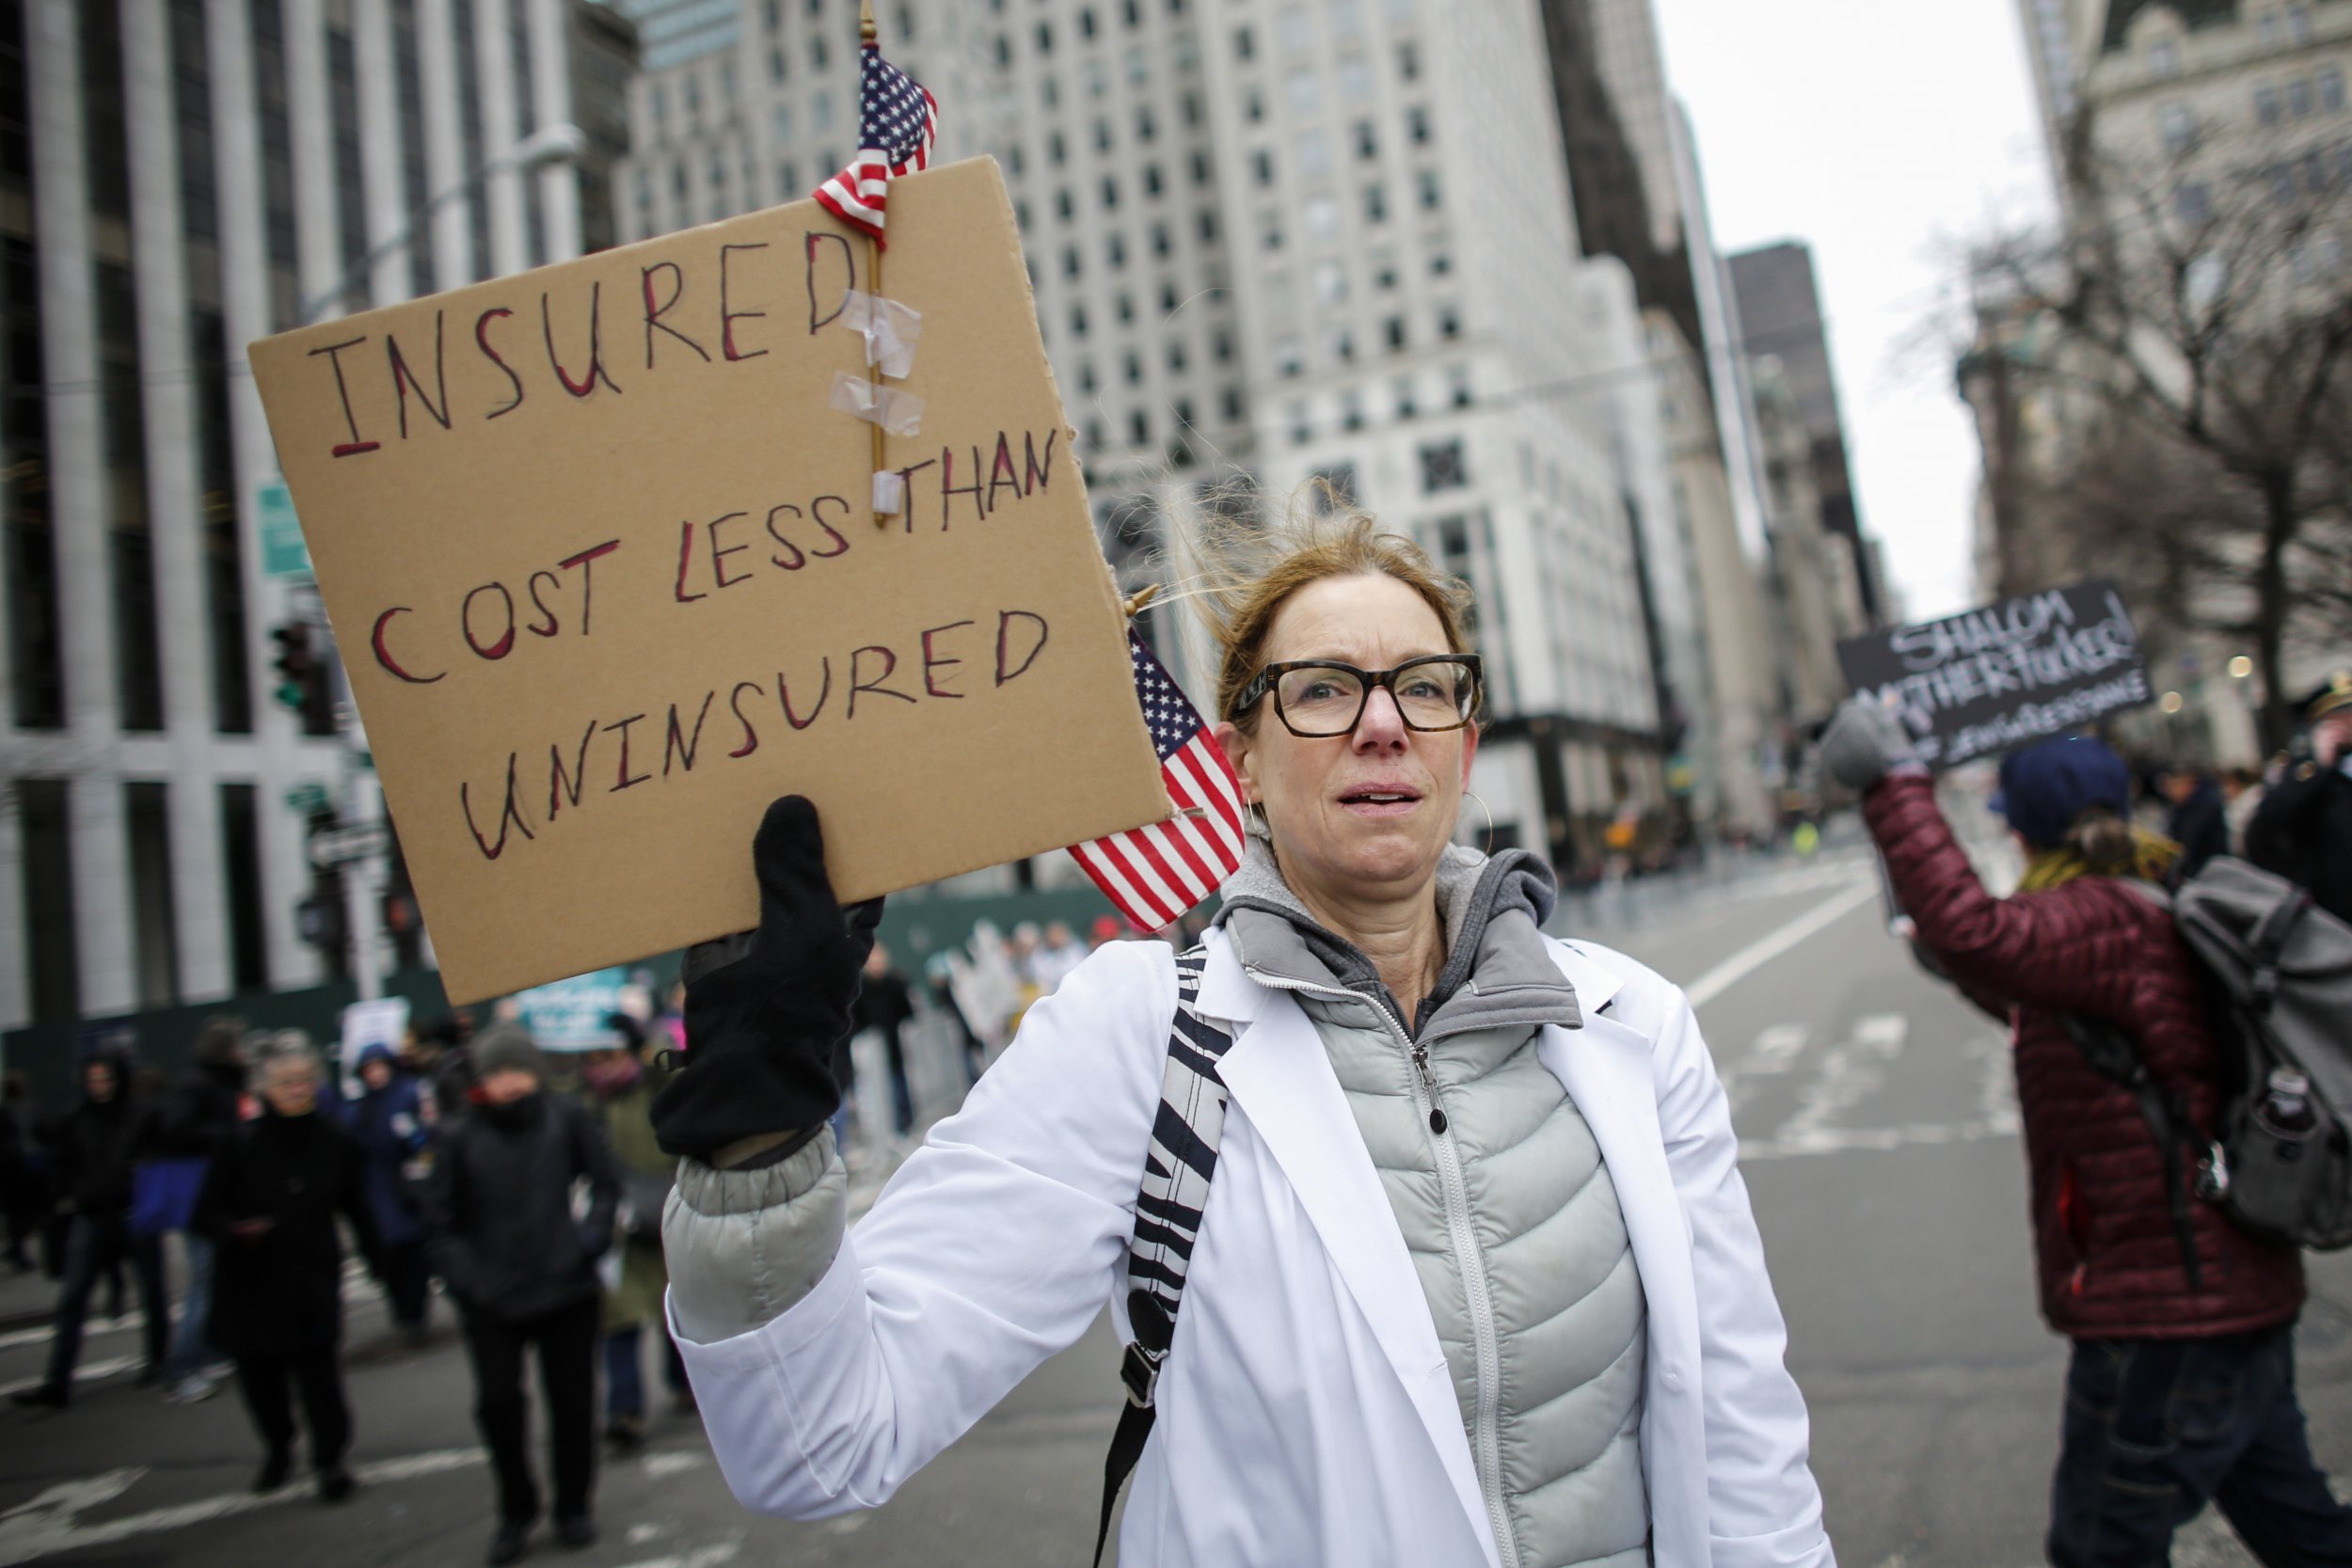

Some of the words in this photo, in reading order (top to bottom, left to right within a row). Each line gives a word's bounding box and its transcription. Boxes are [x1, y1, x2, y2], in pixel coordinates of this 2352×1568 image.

[308, 230, 857, 457] INSURED
[371, 538, 622, 684] COST
[674, 494, 850, 603] LESS
[893, 427, 1057, 533] THAN
[1890, 587, 2075, 673] SHALOM
[460, 610, 1048, 860] UNINSURED
